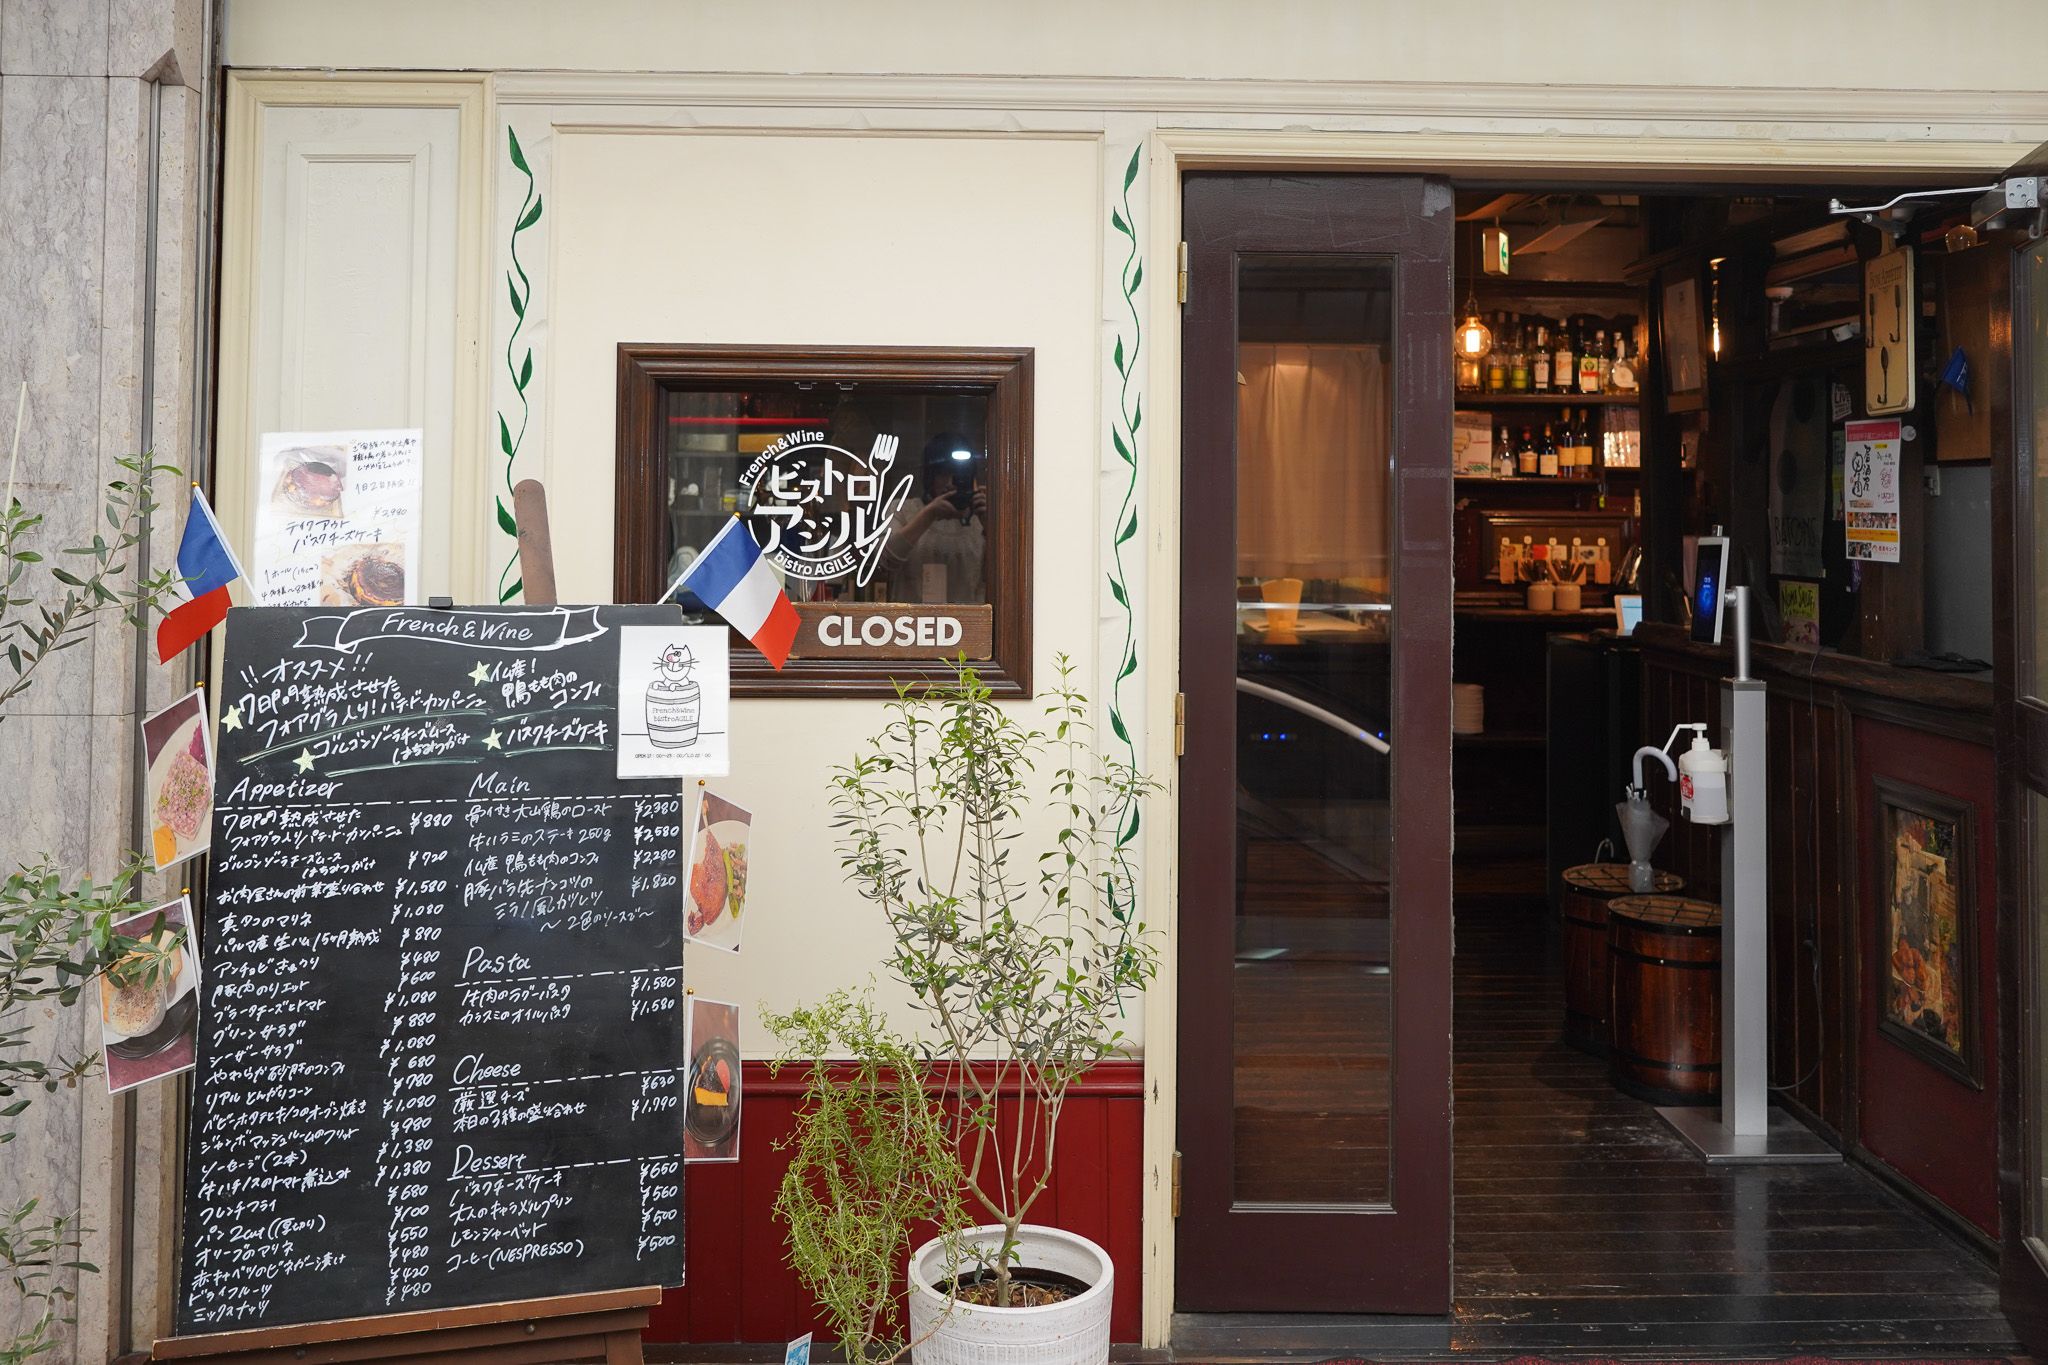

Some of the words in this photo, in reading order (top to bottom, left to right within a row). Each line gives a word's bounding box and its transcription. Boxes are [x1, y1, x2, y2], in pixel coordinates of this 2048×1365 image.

[739, 429, 825, 487] French&Wine
[771, 458, 877, 504] ビストロ
[286, 519, 350, 536] テイクアウト
[754, 504, 894, 554] アジル
[292, 528, 384, 554] バスクチーズケーキ
[774, 550, 813, 575] bistro
[814, 551, 857, 576] AGILE
[817, 615, 963, 647] CLOSED
[501, 670, 578, 709] 鴨もも肉の
[550, 681, 602, 710] コンフィ
[506, 717, 609, 747] バスクチーズケーキ
[392, 734, 470, 766] はちみつがけ
[227, 776, 344, 803] Appetizer
[468, 771, 531, 797] Main
[409, 811, 454, 835] ¥880
[634, 799, 679, 822] ¥2,380
[633, 825, 680, 846] ¥2,580
[301, 856, 377, 879] はちみつがけ
[408, 850, 449, 870] ¥720
[632, 848, 677, 870] ¥2,280
[394, 877, 448, 900] ¥1,580
[217, 911, 313, 936] 真タコのマリネ
[390, 903, 445, 924] ¥1,080
[399, 926, 443, 948] ¥890
[399, 950, 441, 971] ¥480
[461, 945, 532, 979] Pasta
[211, 979, 311, 1008] 豚肉のリエット
[398, 970, 437, 993] ¥600
[630, 976, 677, 998] ¥1,580
[384, 991, 438, 1013] ¥1,080
[630, 998, 676, 1022] ¥1,580
[391, 1012, 437, 1036] ¥880
[379, 1033, 436, 1059] ¥1,080
[388, 1054, 436, 1077] ¥680
[452, 1052, 522, 1085] Cheese
[392, 1073, 434, 1097] ¥780
[641, 1074, 676, 1097] ¥630
[382, 1094, 437, 1118] ¥1,080
[631, 1096, 678, 1122] ¥1,790
[390, 1117, 433, 1140] ¥980
[376, 1138, 433, 1164] ¥1,380
[451, 1143, 527, 1179] Dessert
[374, 1160, 432, 1187] ¥1,380
[640, 1161, 678, 1186] ¥650
[387, 1184, 428, 1206] ¥680
[449, 1170, 563, 1208] バスクチーズケーキ
[641, 1184, 678, 1207] ¥560
[200, 1199, 277, 1226] フレンチフライ
[449, 1193, 573, 1227] 大人のキャラメルプリン
[641, 1208, 677, 1233] ¥500
[387, 1226, 429, 1249] ¥550
[450, 1221, 548, 1249] レモンシャーベット
[195, 1239, 294, 1268] オリーブのマリネ
[388, 1245, 429, 1268] ¥480
[636, 1234, 676, 1262] ¥500
[390, 1265, 430, 1287] ¥420
[188, 1284, 273, 1307] ドライフルーツ
[385, 1282, 432, 1307] ¥480
[193, 1298, 271, 1323] ミックスナッツ
